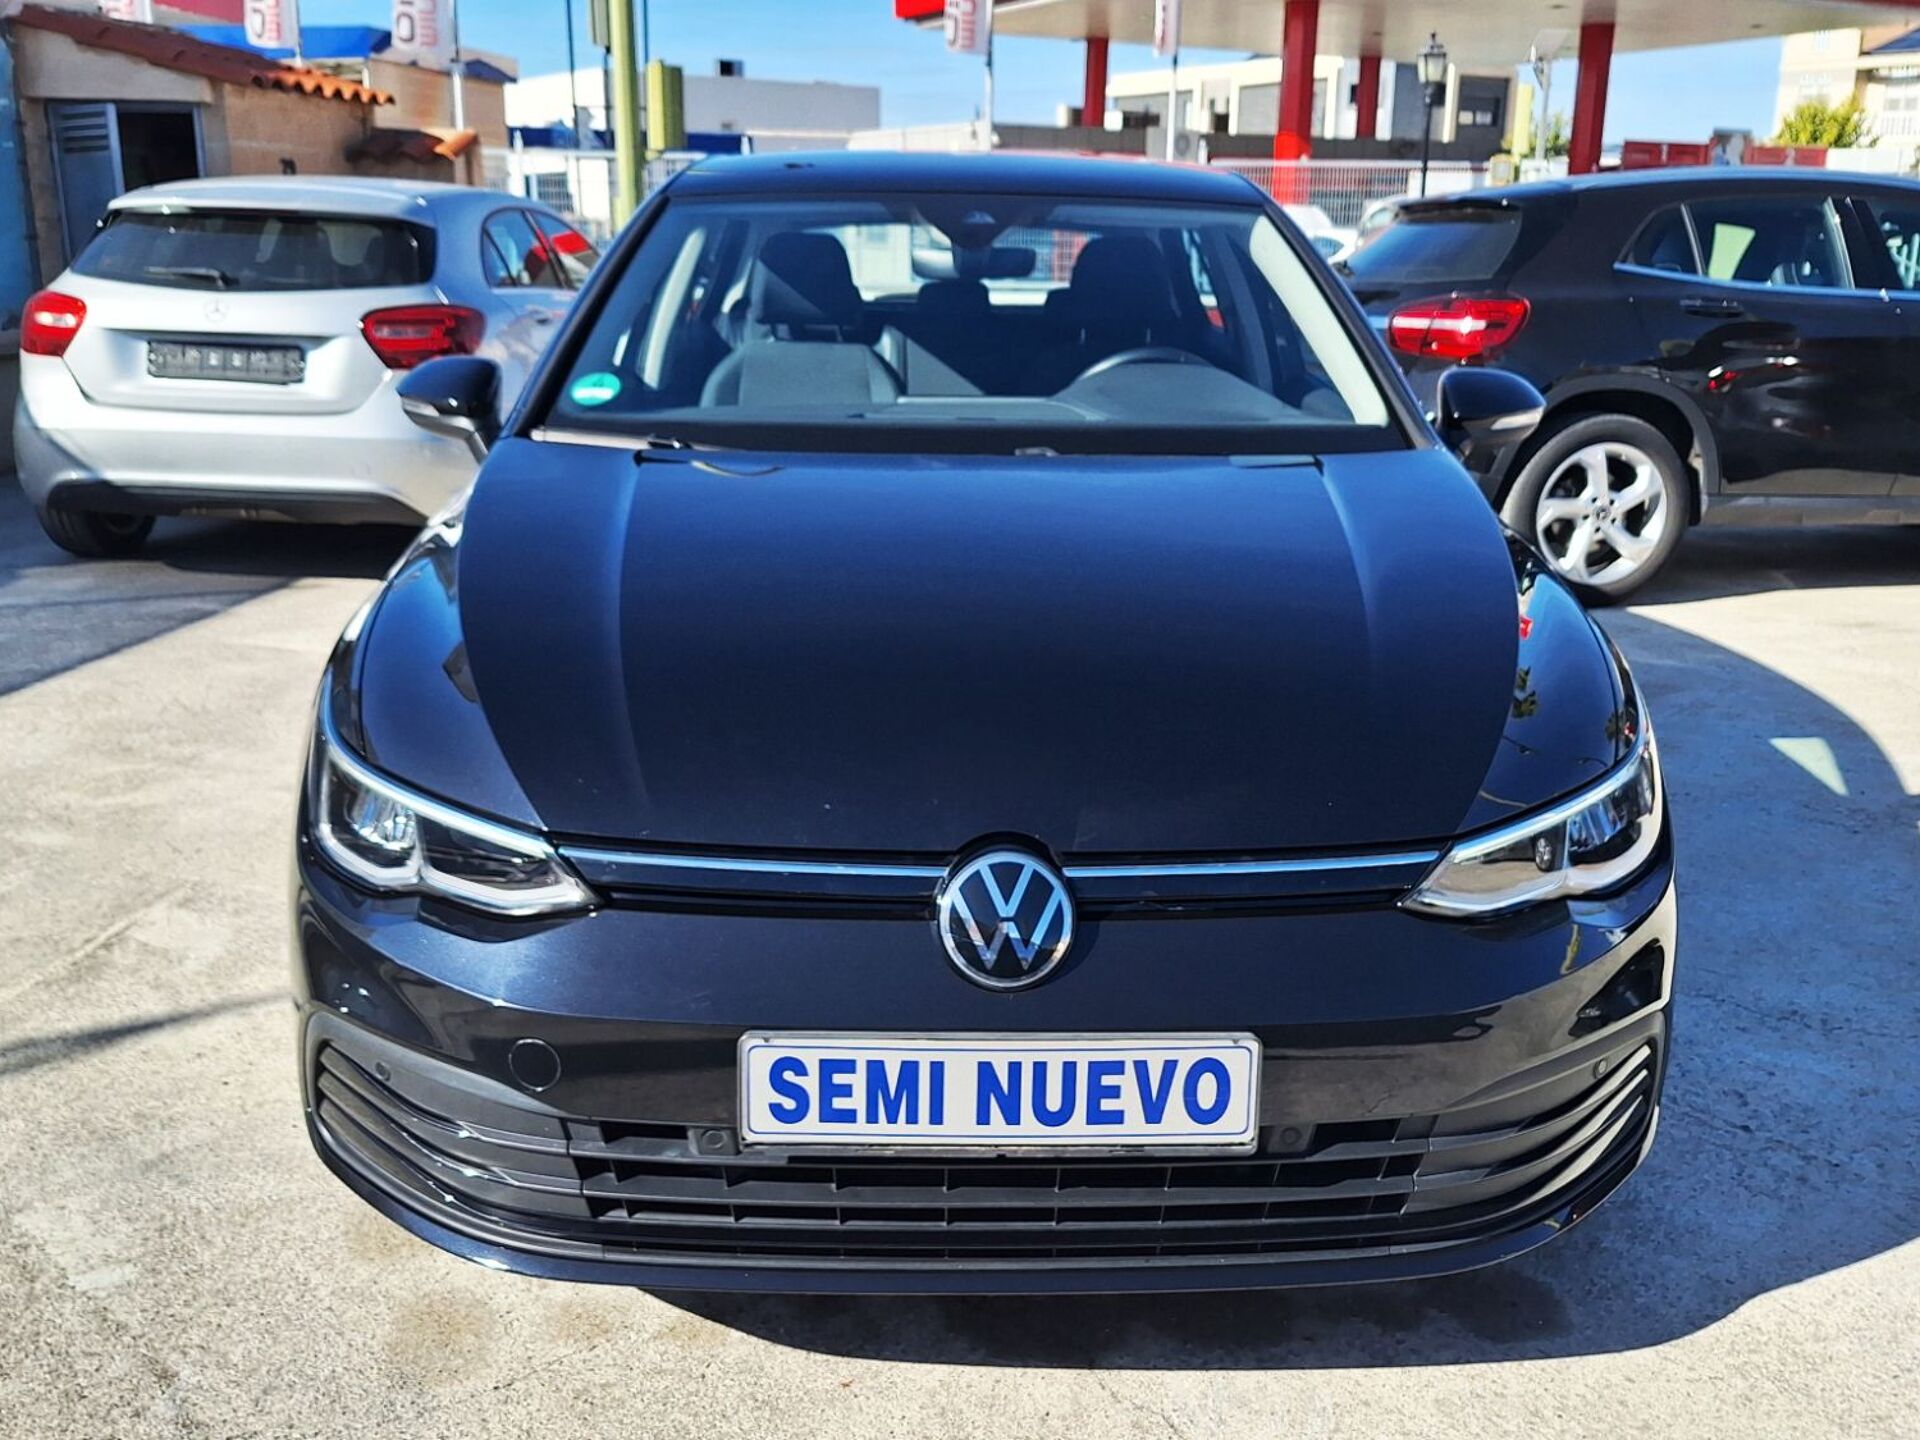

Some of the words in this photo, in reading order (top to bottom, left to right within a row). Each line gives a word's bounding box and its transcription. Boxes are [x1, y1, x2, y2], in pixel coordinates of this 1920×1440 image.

[945, 857, 1068, 978] VW
[768, 1056, 945, 1126] SEMI
[975, 1057, 1232, 1127] NUEVO
